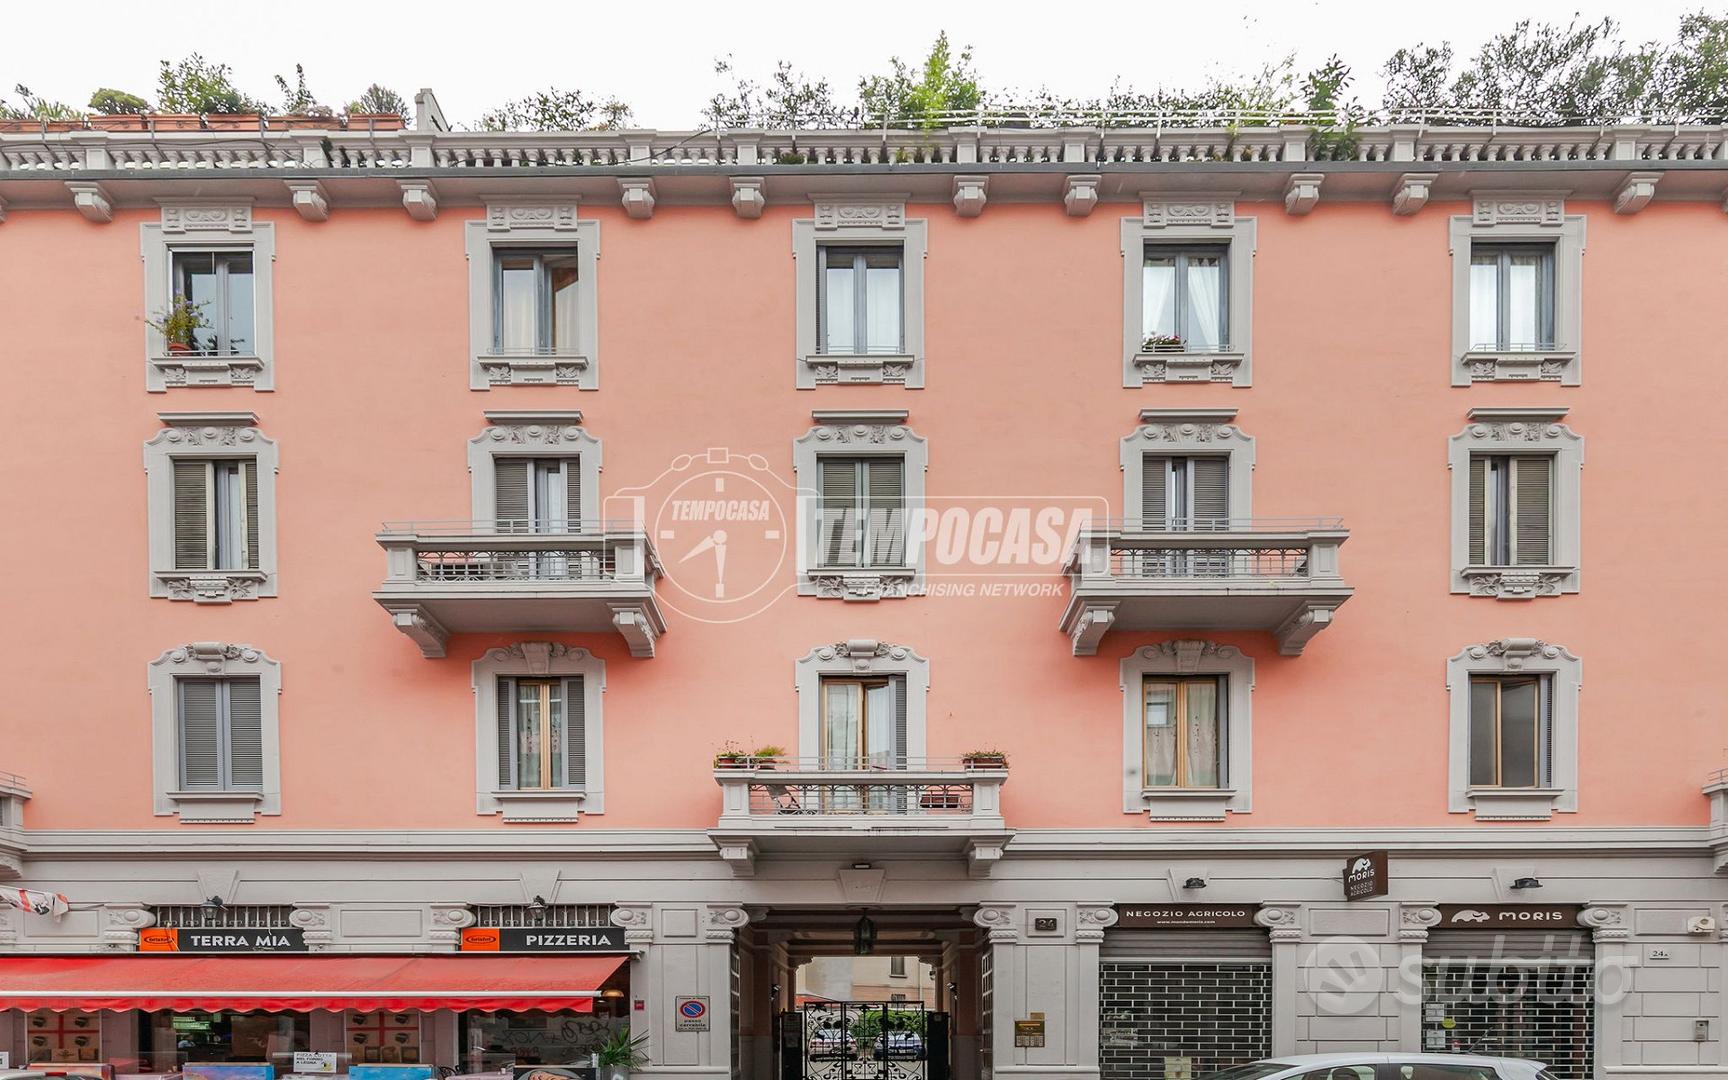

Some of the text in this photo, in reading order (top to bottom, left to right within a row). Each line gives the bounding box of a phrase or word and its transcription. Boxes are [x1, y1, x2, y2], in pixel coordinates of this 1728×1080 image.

[1348, 868, 1375, 883] MORIS
[1499, 911, 1563, 921] MORIS
[190, 935, 291, 947] TERRA MIA
[526, 934, 612, 946] PIZZERIA
